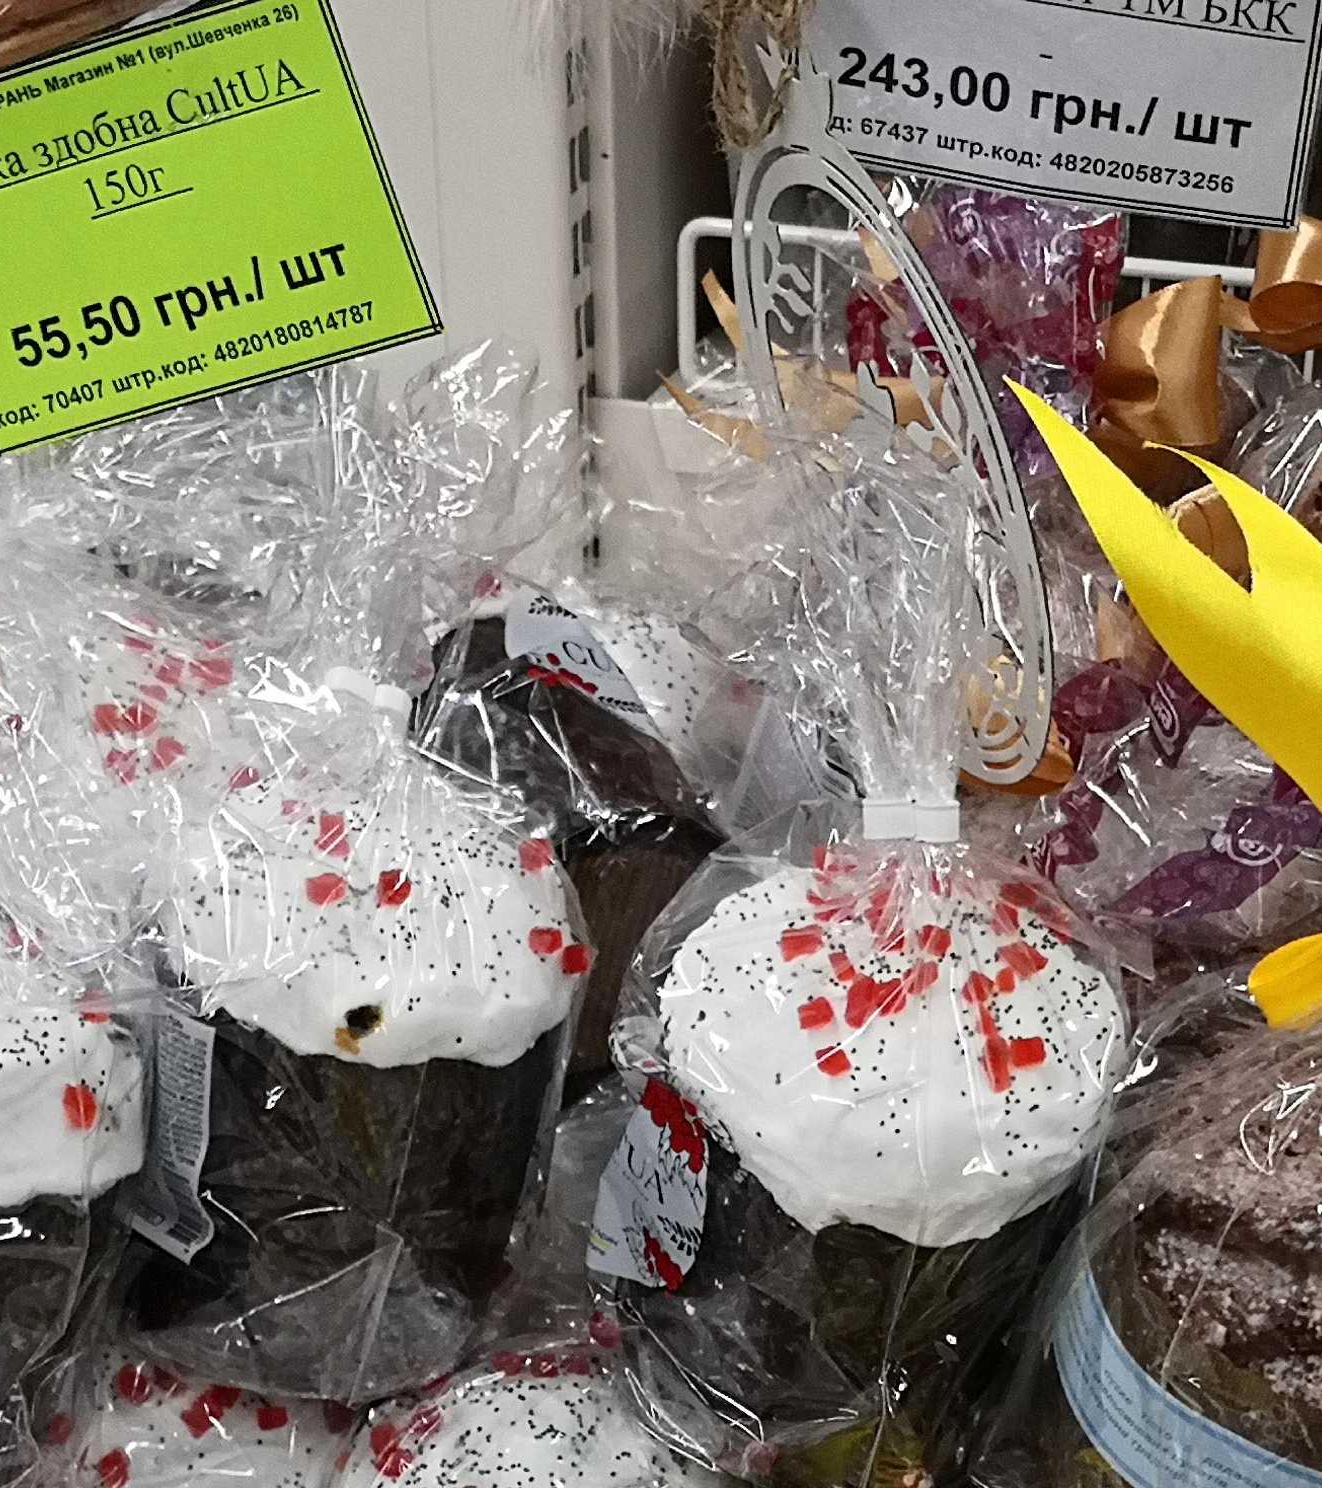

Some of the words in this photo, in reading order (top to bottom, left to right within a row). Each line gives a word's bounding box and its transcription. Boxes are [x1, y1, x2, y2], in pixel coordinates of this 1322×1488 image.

[44, 61, 115, 95] Магазин
[117, 48, 145, 72] №1
[149, 13, 271, 64] (вул.Шевченка
[273, 3, 301, 27] 26)
[1201, 0, 1297, 36] БКК
[37, 112, 163, 170] здобна
[166, 58, 307, 126] CultUA
[838, 47, 1011, 113] 243,00
[1030, 88, 1159, 138] грн./
[1174, 110, 1252, 150] шт
[84, 166, 167, 215] 150г
[860, 117, 930, 146] 67437
[936, 131, 1043, 169] штр.код:
[1049, 152, 1235, 194] 4820205873256
[11, 296, 141, 370] 55,50
[154, 256, 263, 334] грн./
[281, 244, 348, 291] шт
[43, 379, 105, 416] 70407
[111, 352, 210, 396] штр.код:
[213, 300, 375, 364] 4820180814787
